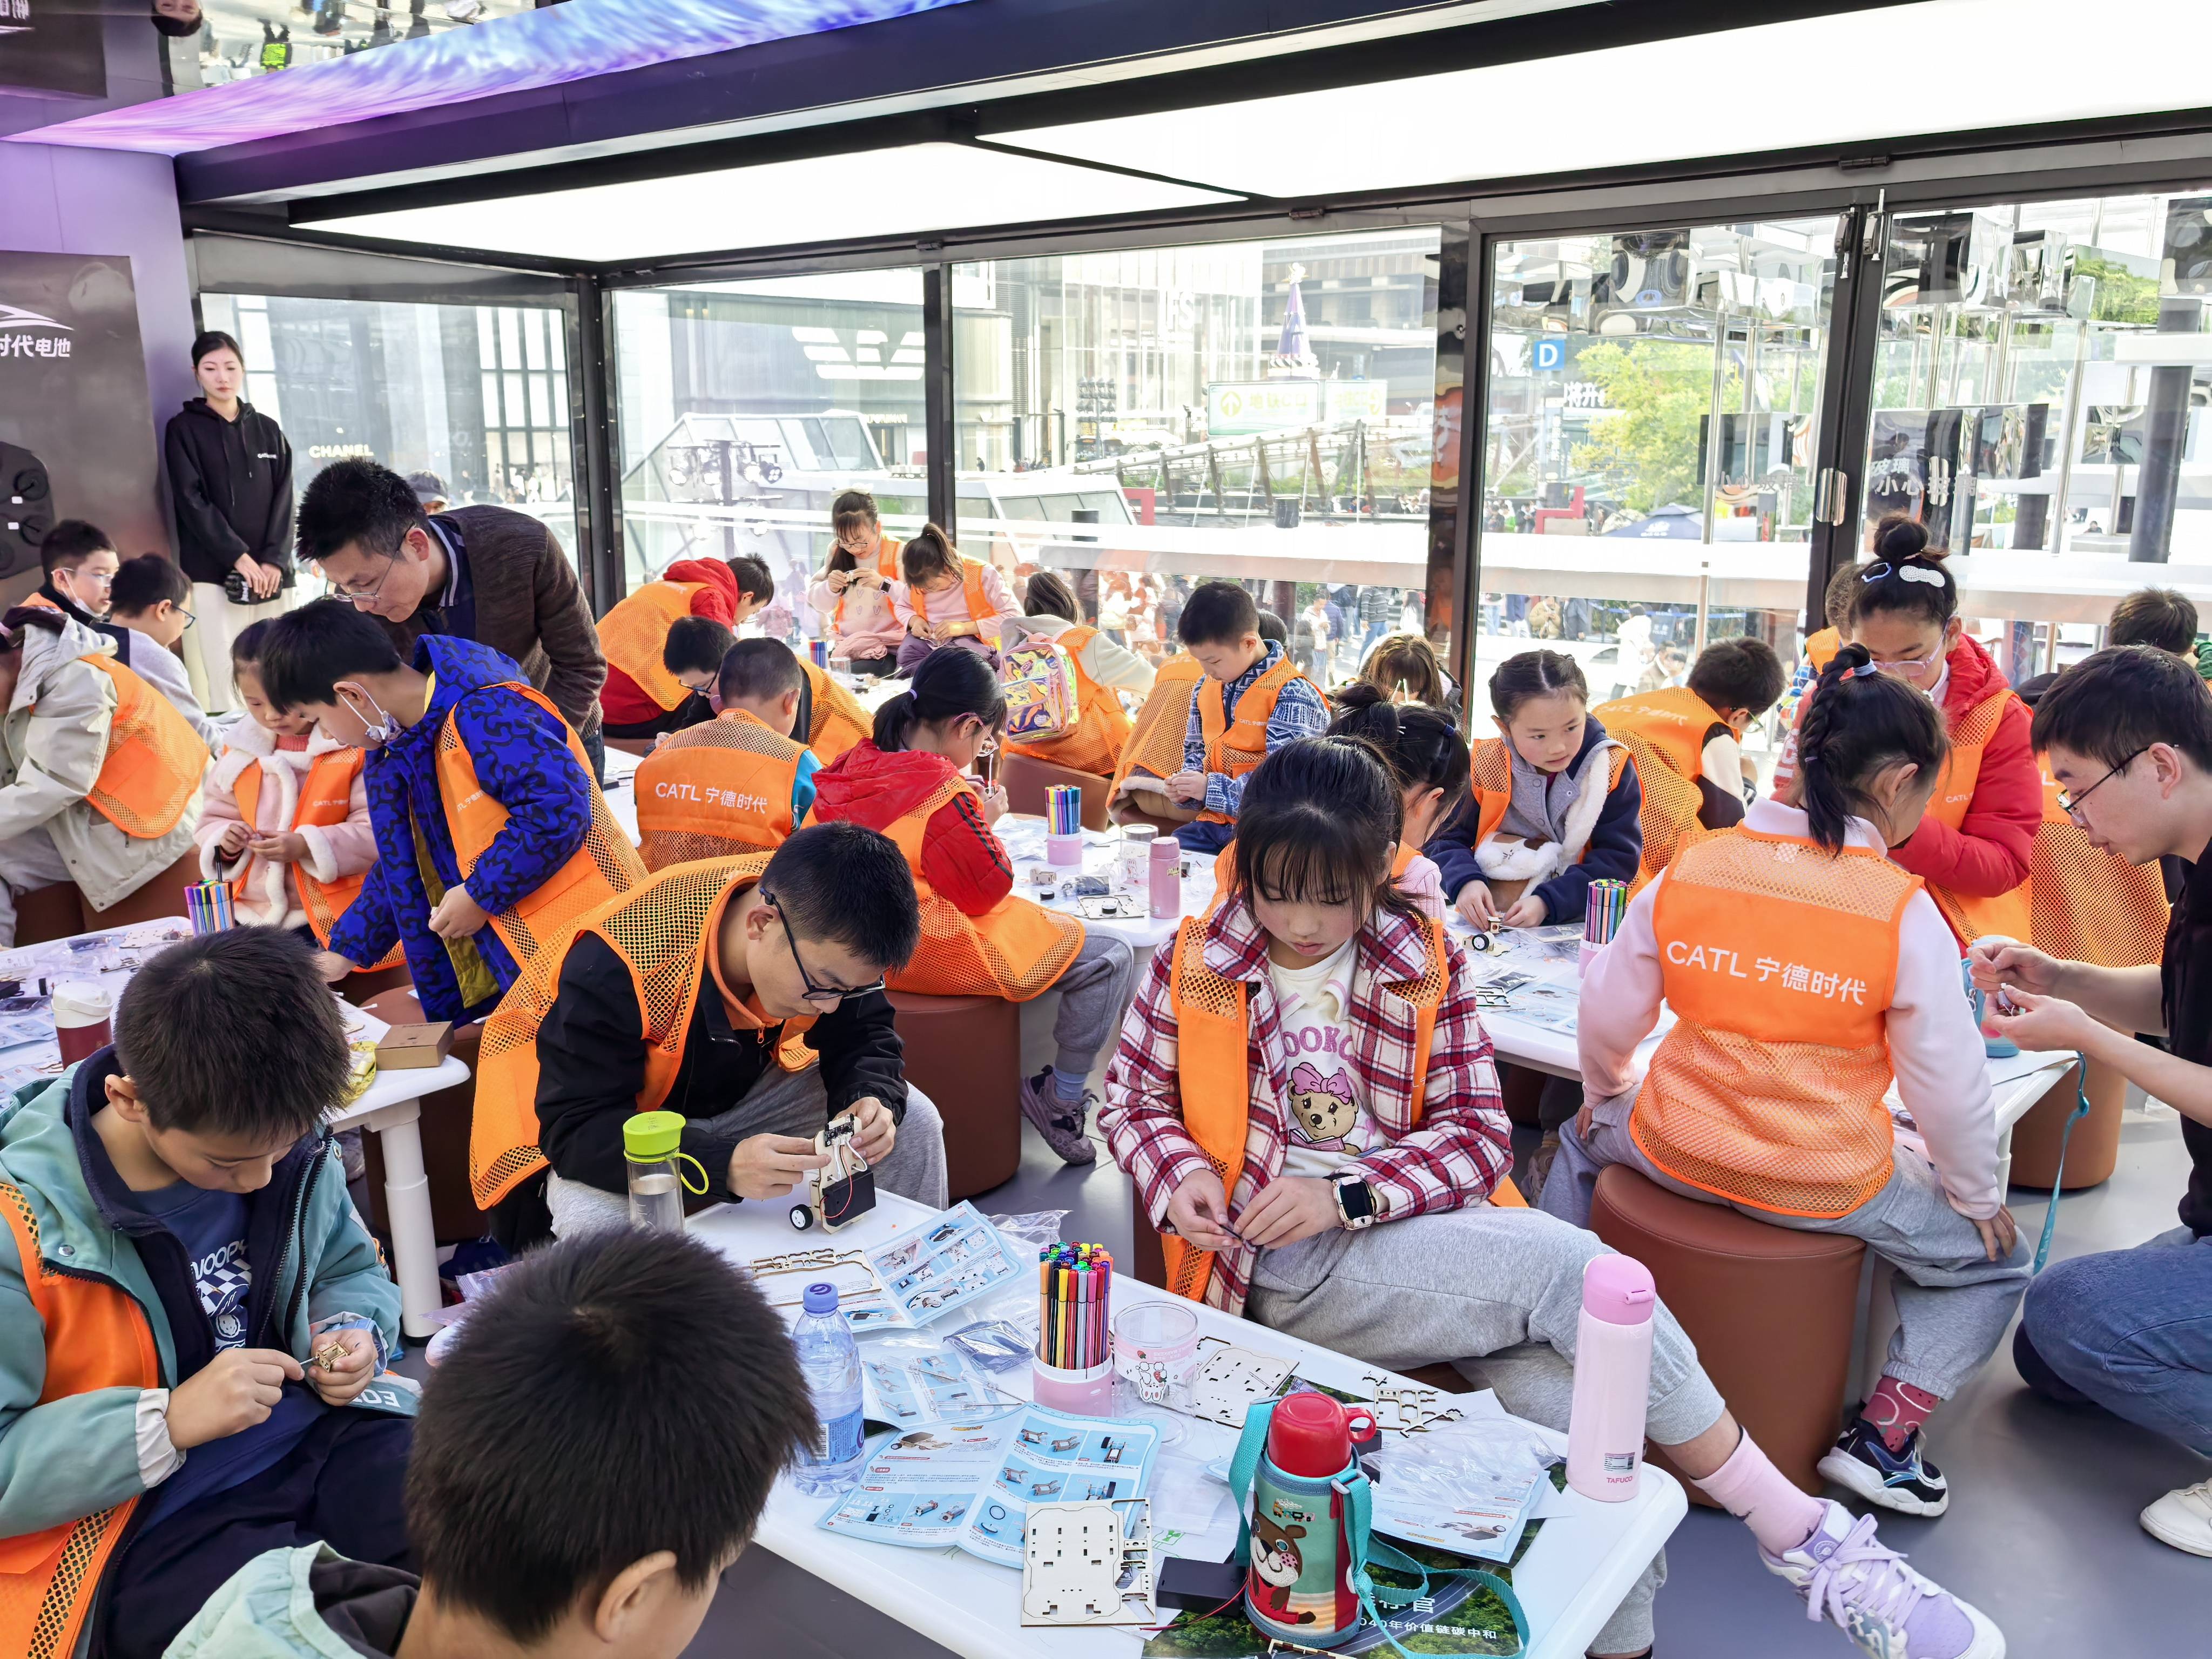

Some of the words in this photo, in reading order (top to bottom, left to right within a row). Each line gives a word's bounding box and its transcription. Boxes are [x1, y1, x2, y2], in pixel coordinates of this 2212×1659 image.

[1539, 343, 1558, 367] D
[309, 444, 374, 458] CHANEL
[655, 782, 701, 802] CATL
[705, 787, 768, 814] 宁德时代
[1945, 794, 1968, 803] CATL
[1667, 941, 1747, 979] CATL
[1754, 956, 1866, 1006] 宁德时代
